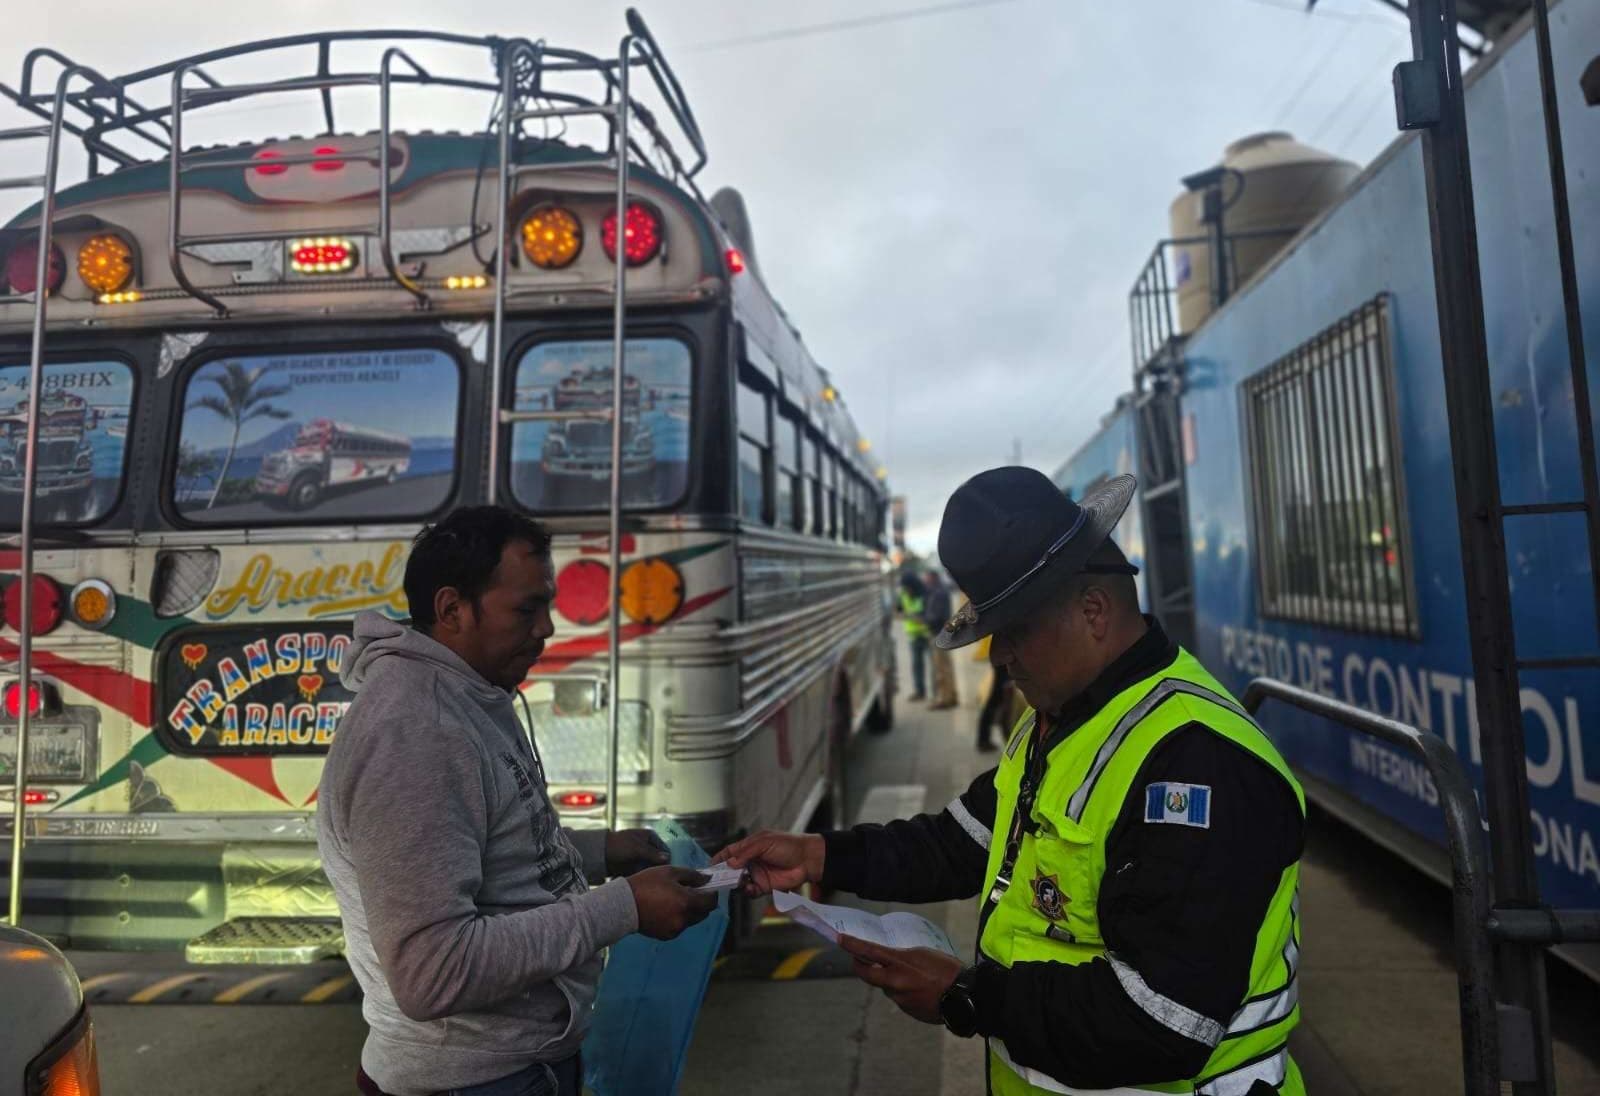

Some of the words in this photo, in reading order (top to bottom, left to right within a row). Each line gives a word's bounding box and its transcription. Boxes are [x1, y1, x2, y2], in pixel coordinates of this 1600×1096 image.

[15, 371, 114, 391] 48BHX
[206, 540, 411, 618] Aracel
[168, 632, 352, 746] TRANSPO
[1219, 624, 1293, 684] PUESTO
[1296, 641, 1335, 699] DE
[218, 701, 352, 746] ARACE
